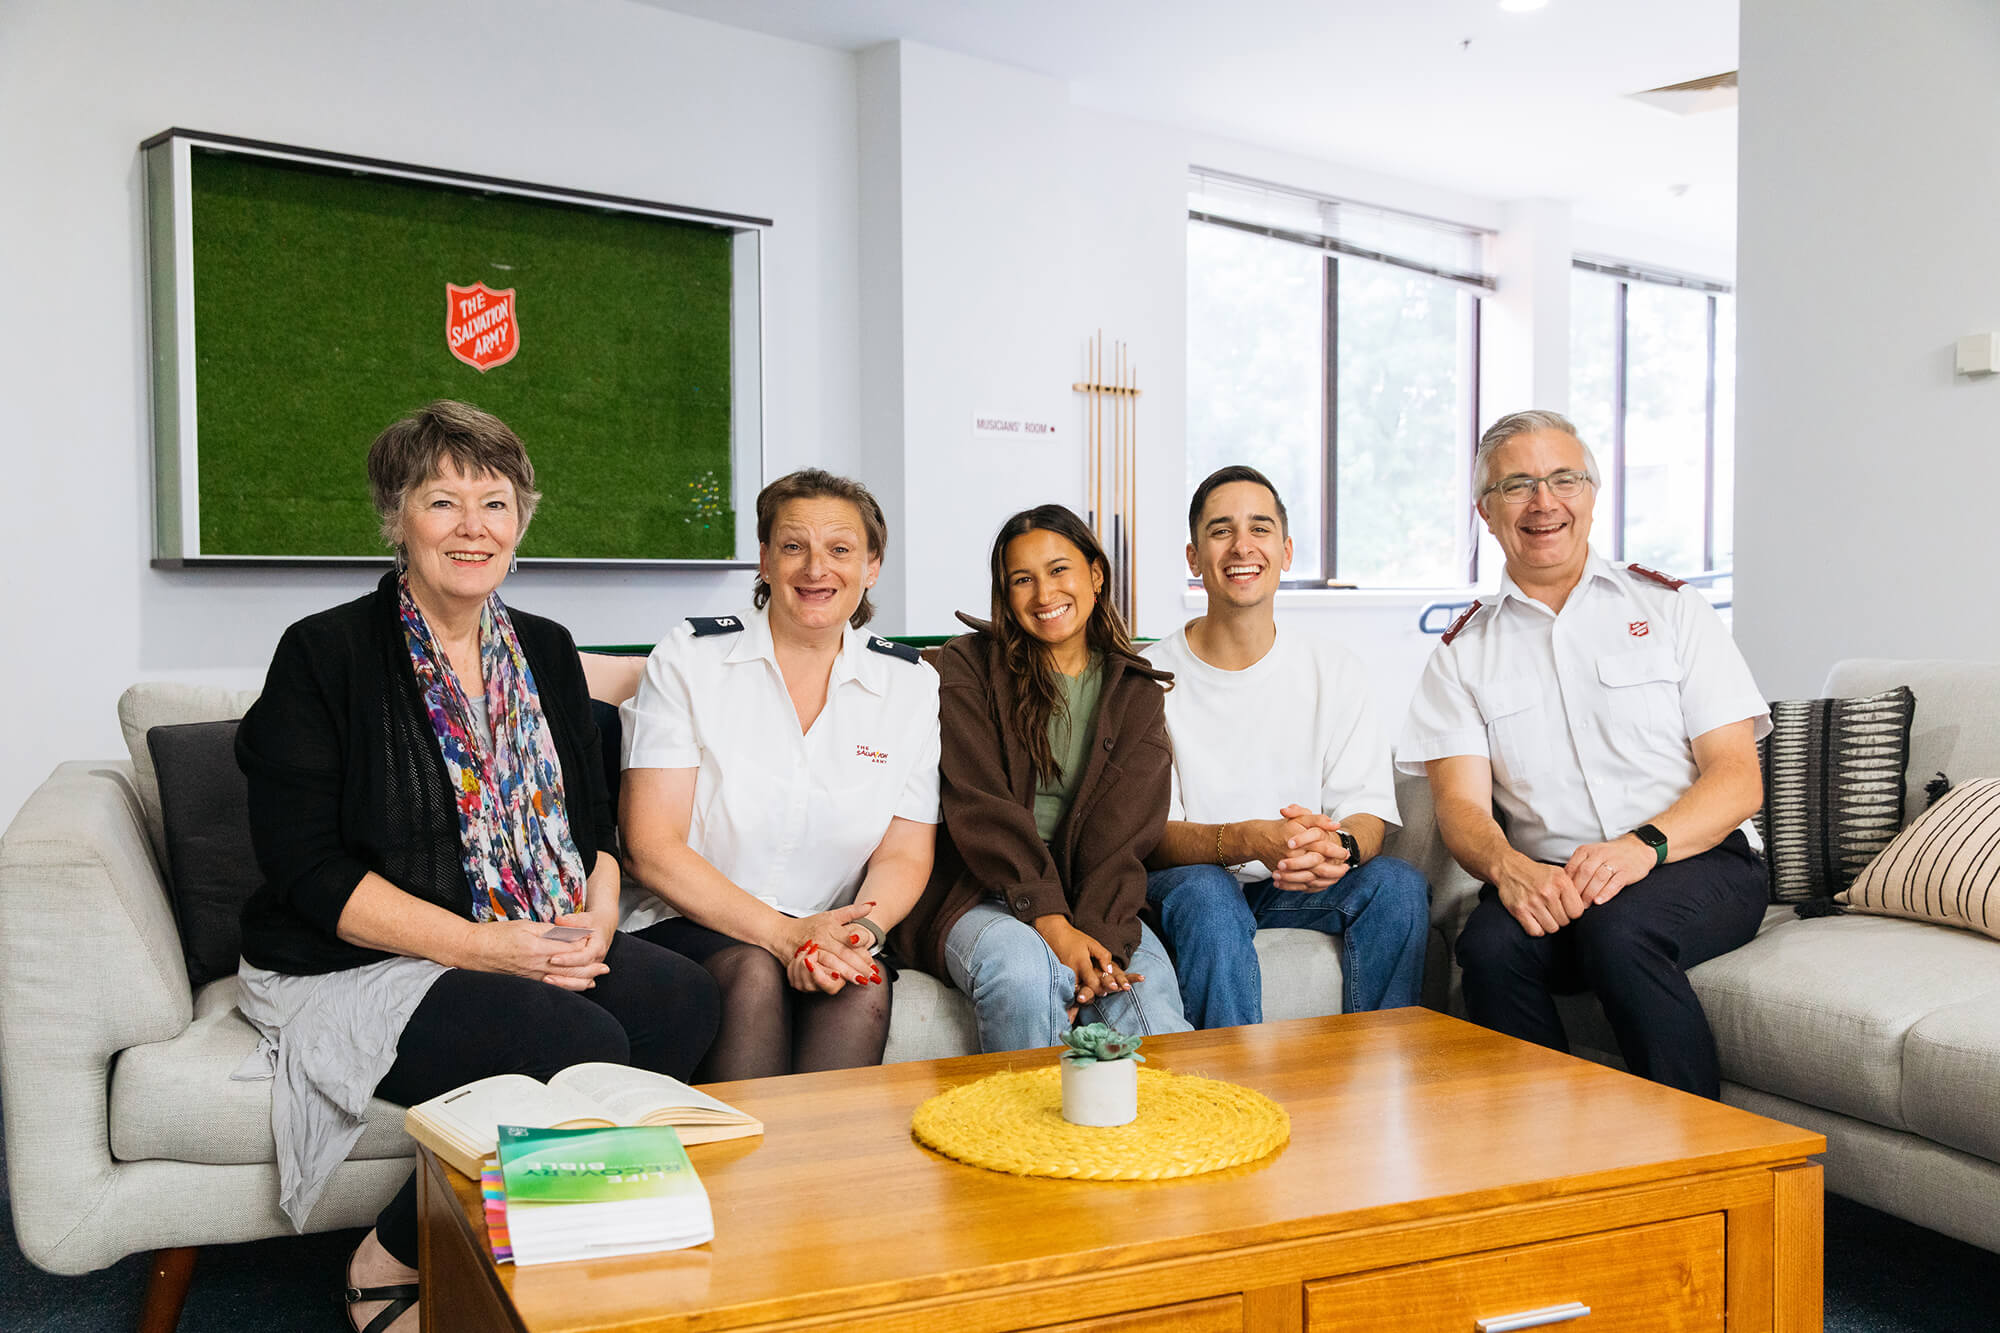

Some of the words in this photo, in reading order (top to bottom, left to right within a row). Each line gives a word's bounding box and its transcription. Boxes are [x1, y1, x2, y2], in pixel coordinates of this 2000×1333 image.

[460, 293, 486, 318] THE
[451, 298, 508, 347] SALVATION
[474, 322, 508, 359] ARMY
[1024, 421, 1047, 433] ROOM
[523, 1164, 680, 1177] RECOVERY
[527, 1161, 605, 1171] BIBLE
[605, 1171, 665, 1184] LIFE
